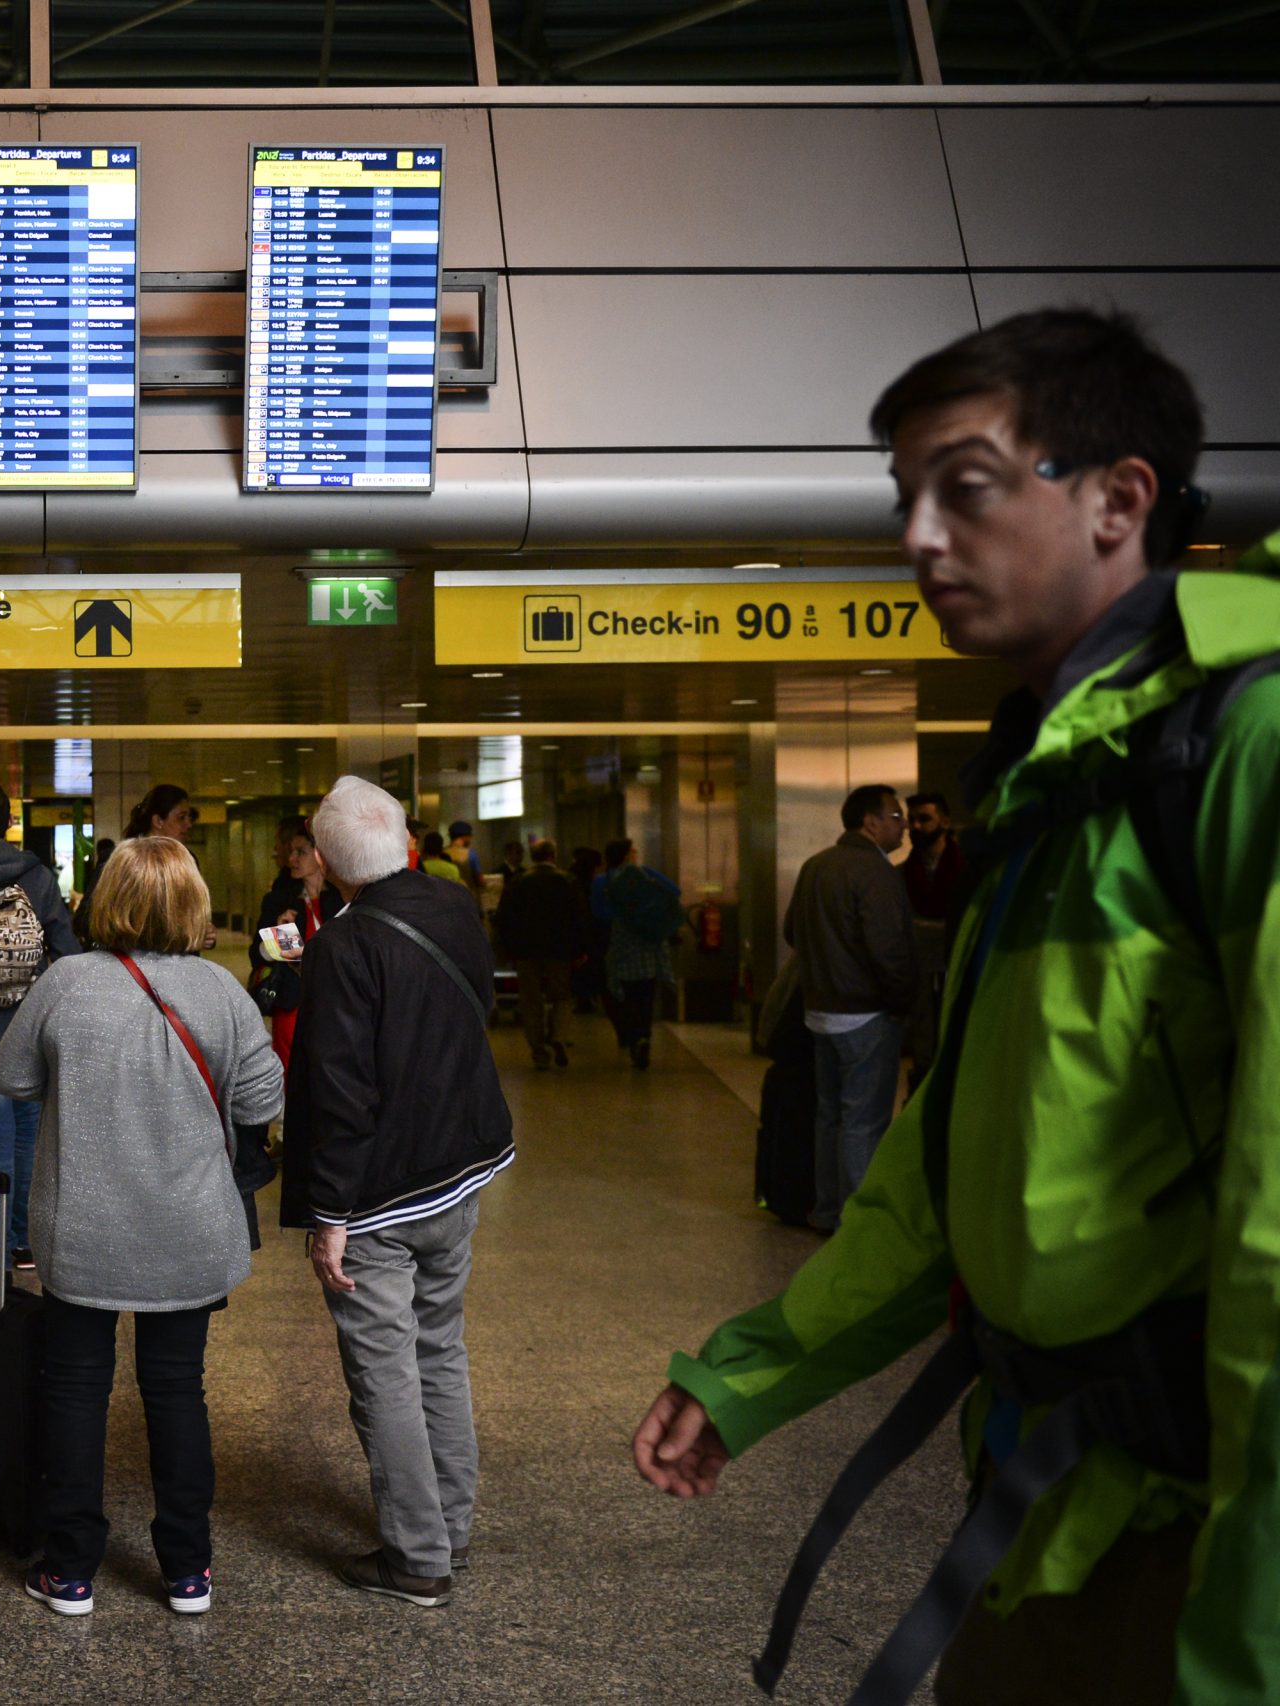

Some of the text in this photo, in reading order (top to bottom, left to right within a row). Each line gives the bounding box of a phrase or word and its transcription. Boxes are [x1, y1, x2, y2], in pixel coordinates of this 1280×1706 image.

[31, 149, 81, 160] _Departures
[112, 154, 130, 163] 9:34
[302, 151, 336, 160] Partidas
[337, 151, 387, 161] _Departures
[417, 156, 436, 165] 9:34
[587, 600, 920, 640] Check-in 90 a to 107
